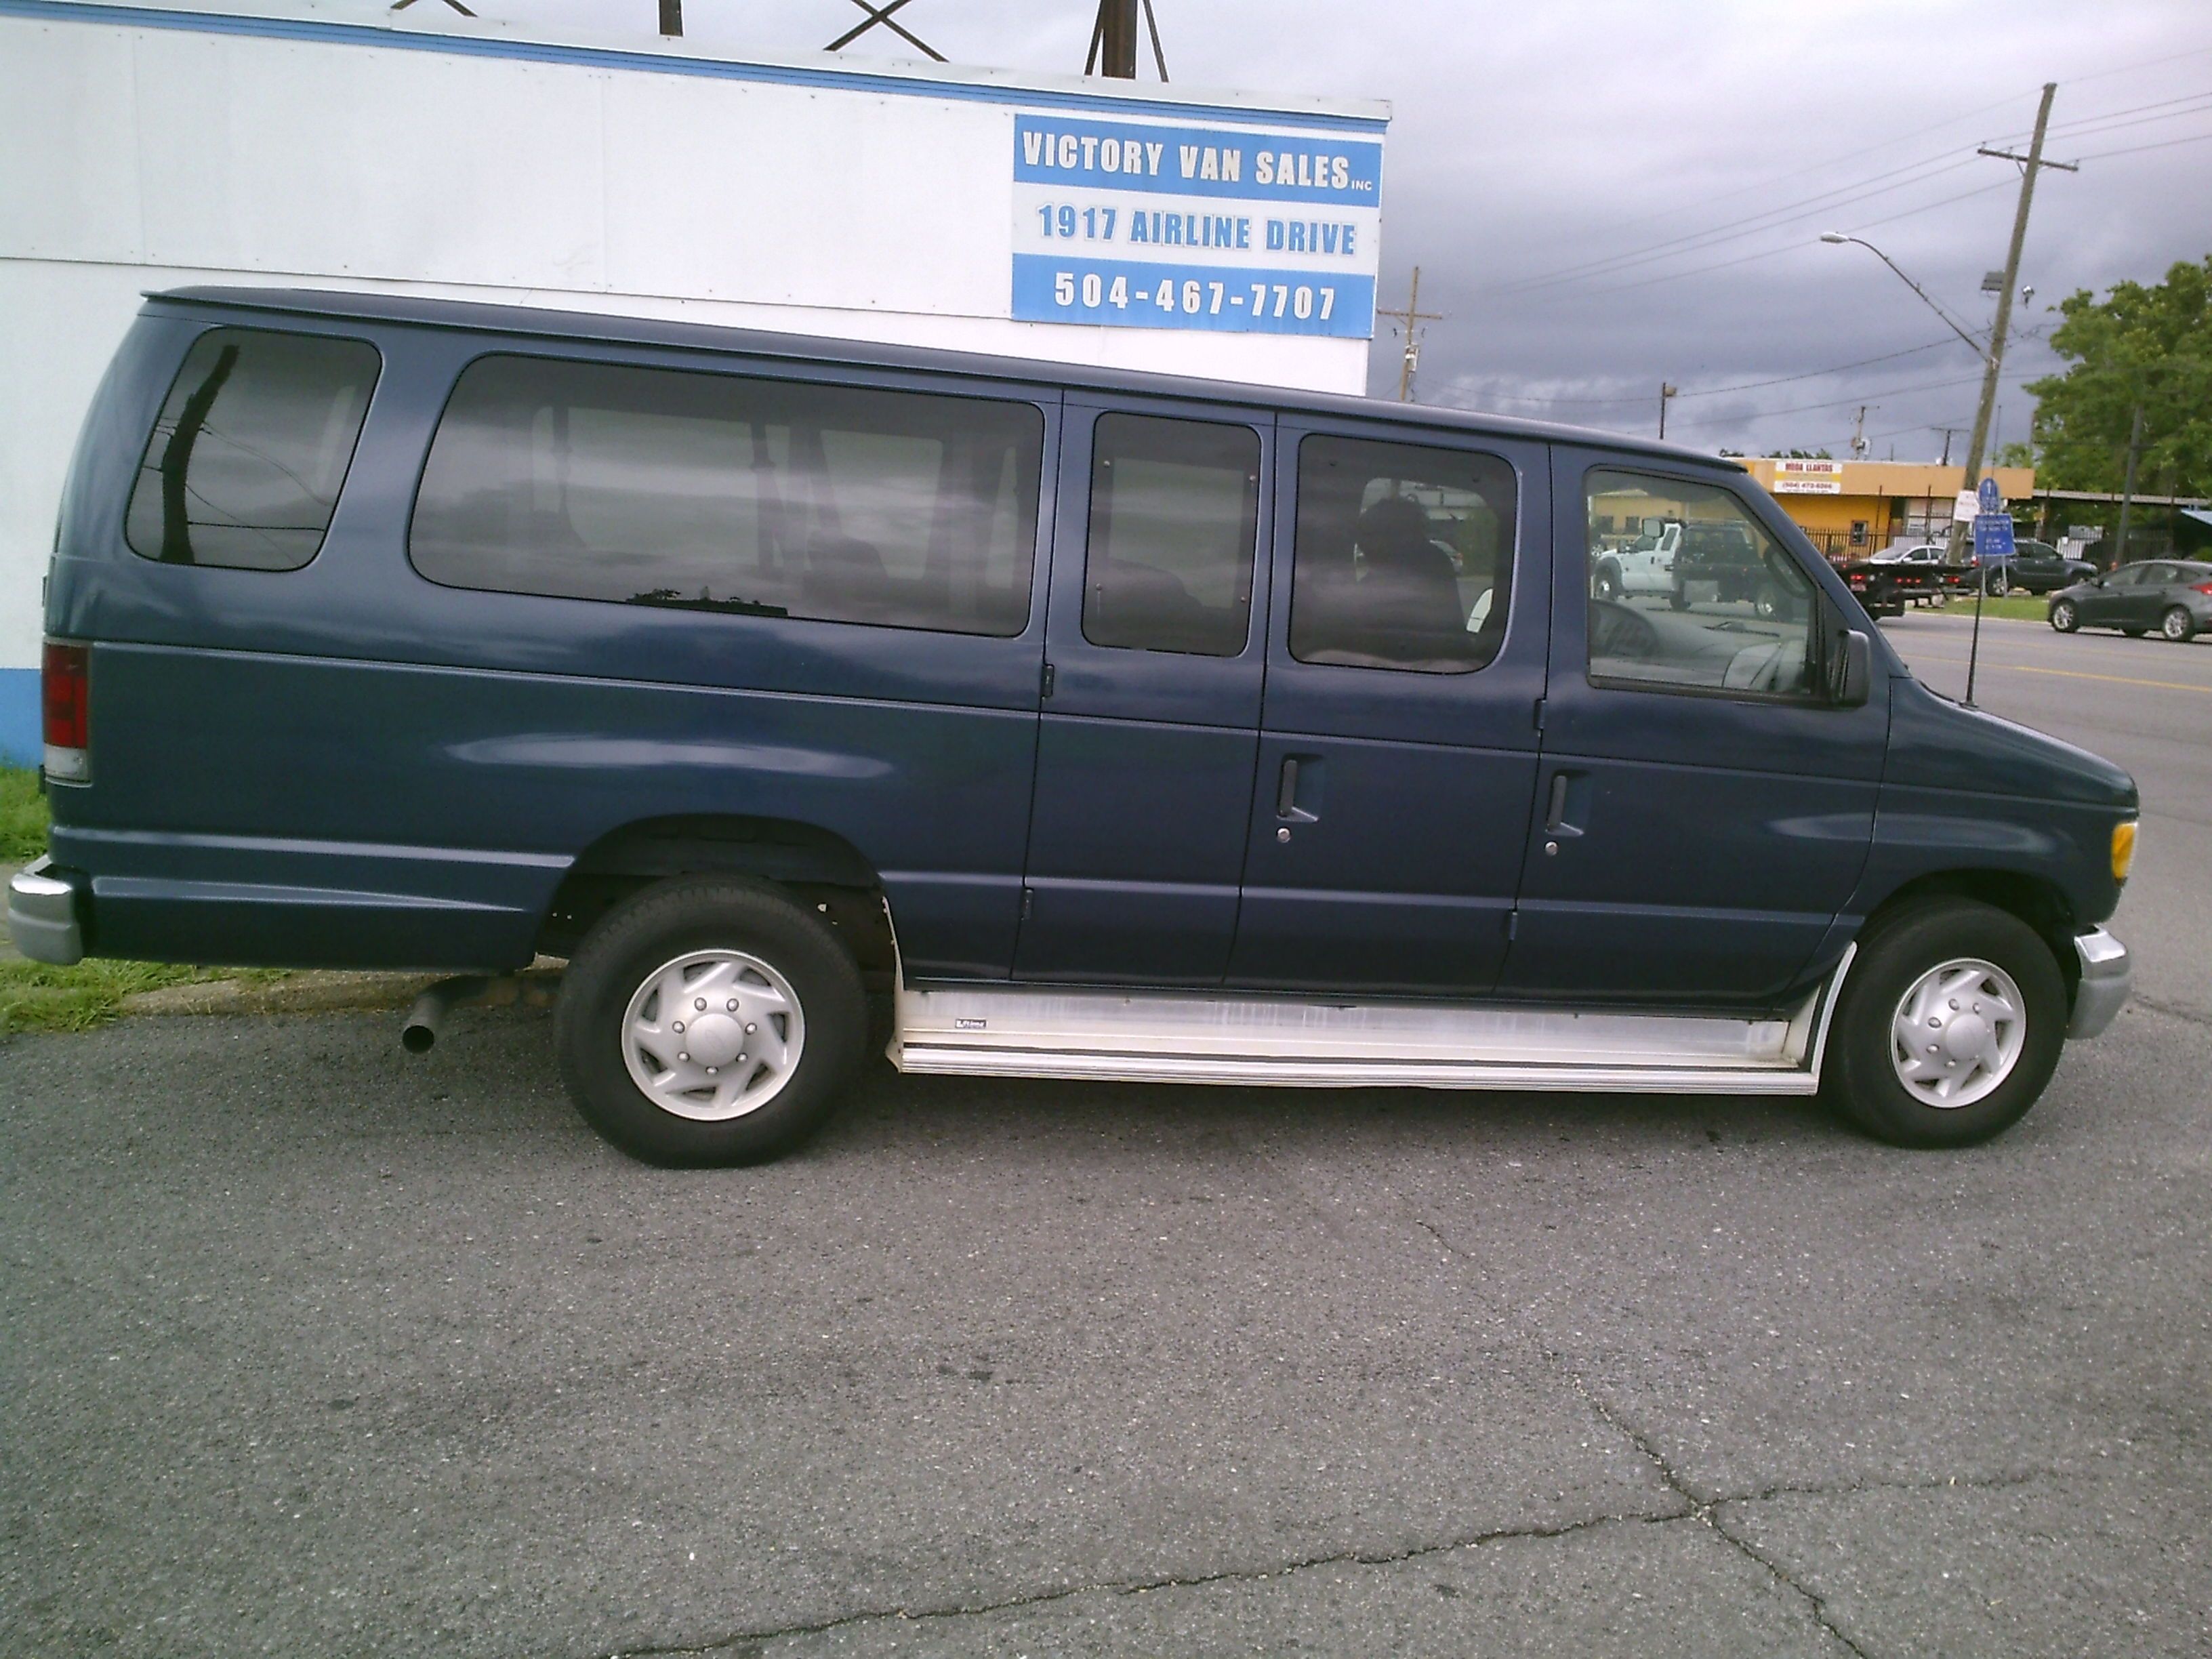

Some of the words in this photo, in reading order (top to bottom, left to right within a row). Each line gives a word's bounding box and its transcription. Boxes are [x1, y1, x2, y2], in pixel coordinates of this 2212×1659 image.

[1023, 131, 1164, 175] VICTORY
[1179, 145, 1241, 182] VAN
[1255, 151, 1349, 190] SALES
[1351, 180, 1372, 191] INC
[1038, 203, 1117, 242] 1917
[1129, 210, 1250, 250] AIRLINE
[1265, 218, 1356, 255] DRIVE
[1054, 272, 1335, 321] 504-467-7707
